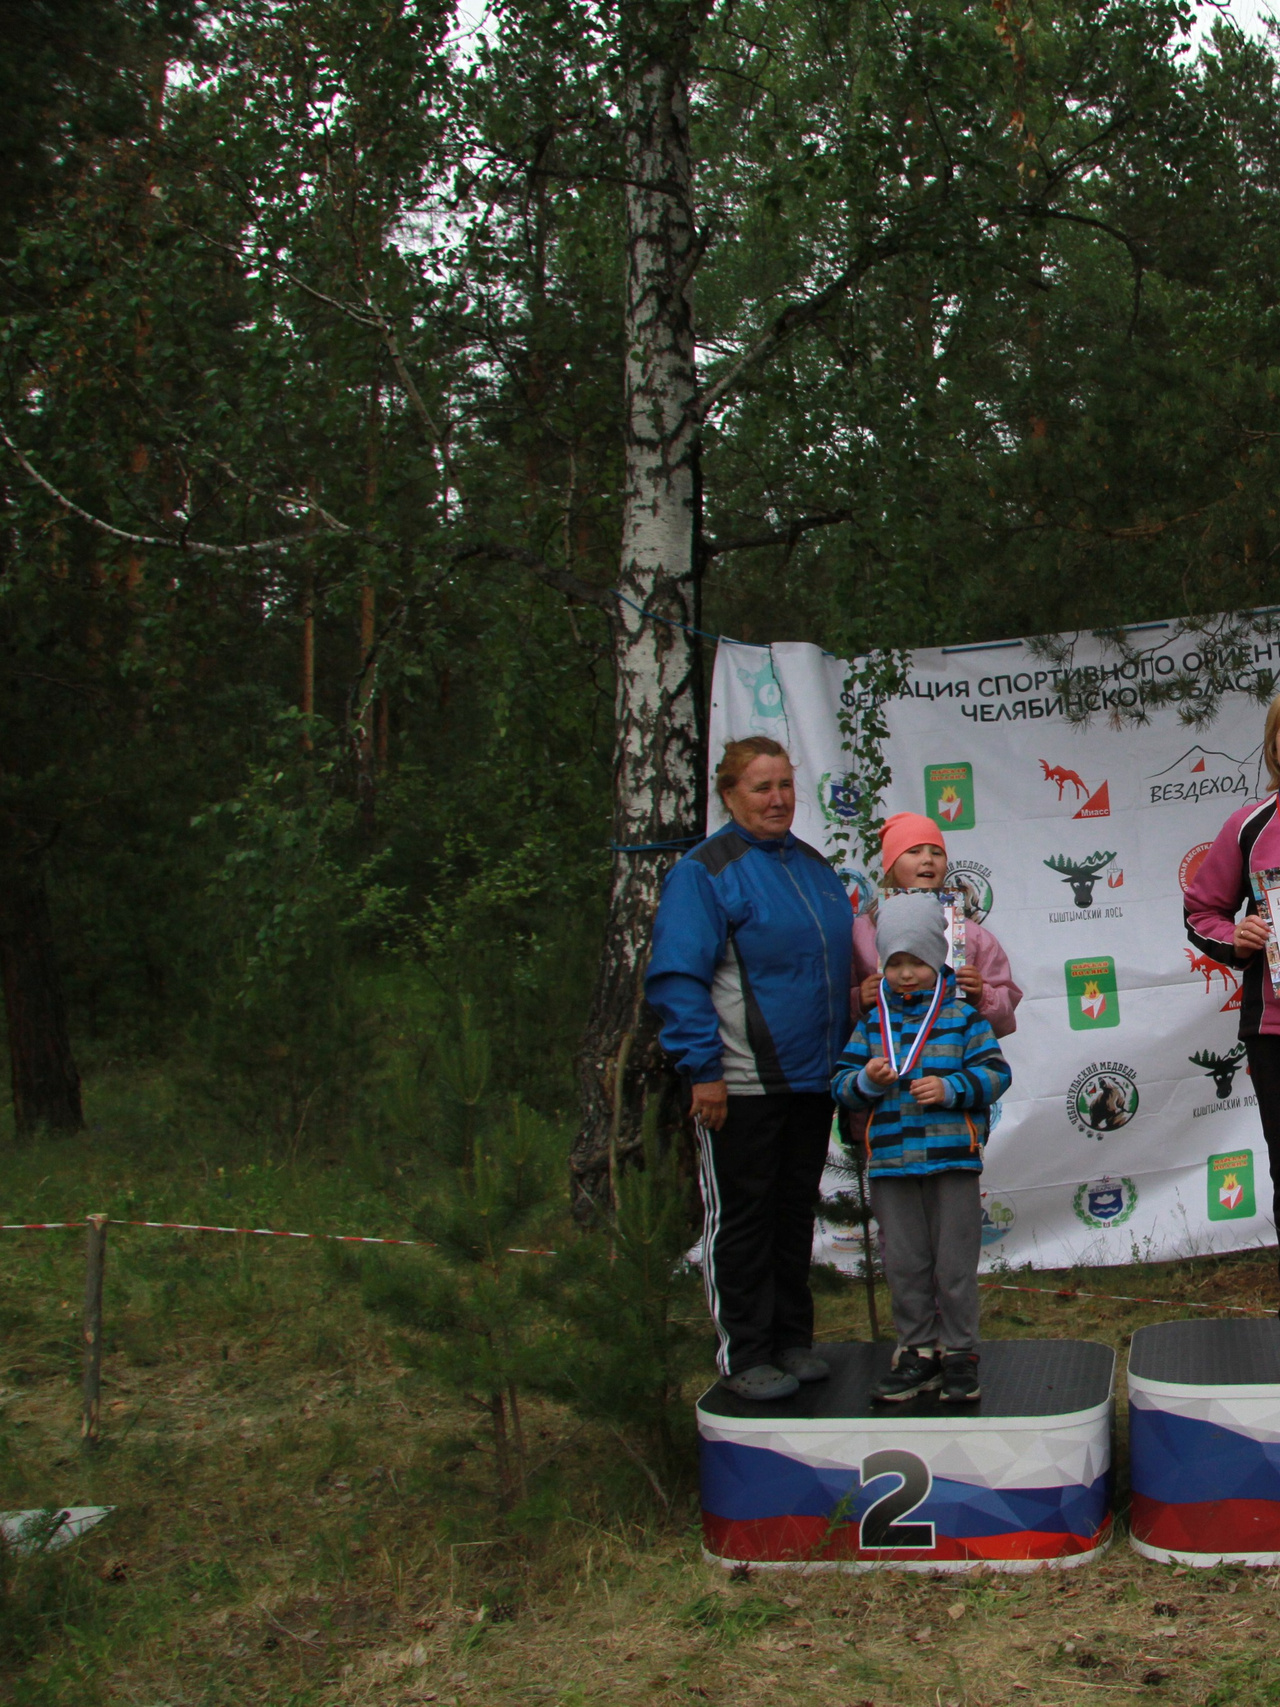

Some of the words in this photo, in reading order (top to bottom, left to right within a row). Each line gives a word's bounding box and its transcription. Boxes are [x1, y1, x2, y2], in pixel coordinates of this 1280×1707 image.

[840, 678, 970, 711] ФЕАЦИЯ
[978, 655, 1176, 697] СПОРТИВНОГО
[1150, 774, 1249, 804] ВЕЗДЕХОД
[1081, 808, 1109, 817] Миасс
[956, 860, 992, 879] МЕДВЕДЬ
[1180, 862, 1189, 892] ОРЯЧАЯ
[1048, 908, 1102, 924] КЫШТЫМСКИЙ
[1104, 906, 1123, 918] ЛОСЬ
[1066, 1062, 1099, 1126] ЧЕБАРКУЛЬСКИЙ
[1100, 1061, 1137, 1080] МЕДВЕДЬ
[1193, 1096, 1241, 1119] КЫШТЫМСКИЙ
[1243, 1094, 1258, 1107] ЛОС
[858, 1449, 936, 1549] 2
